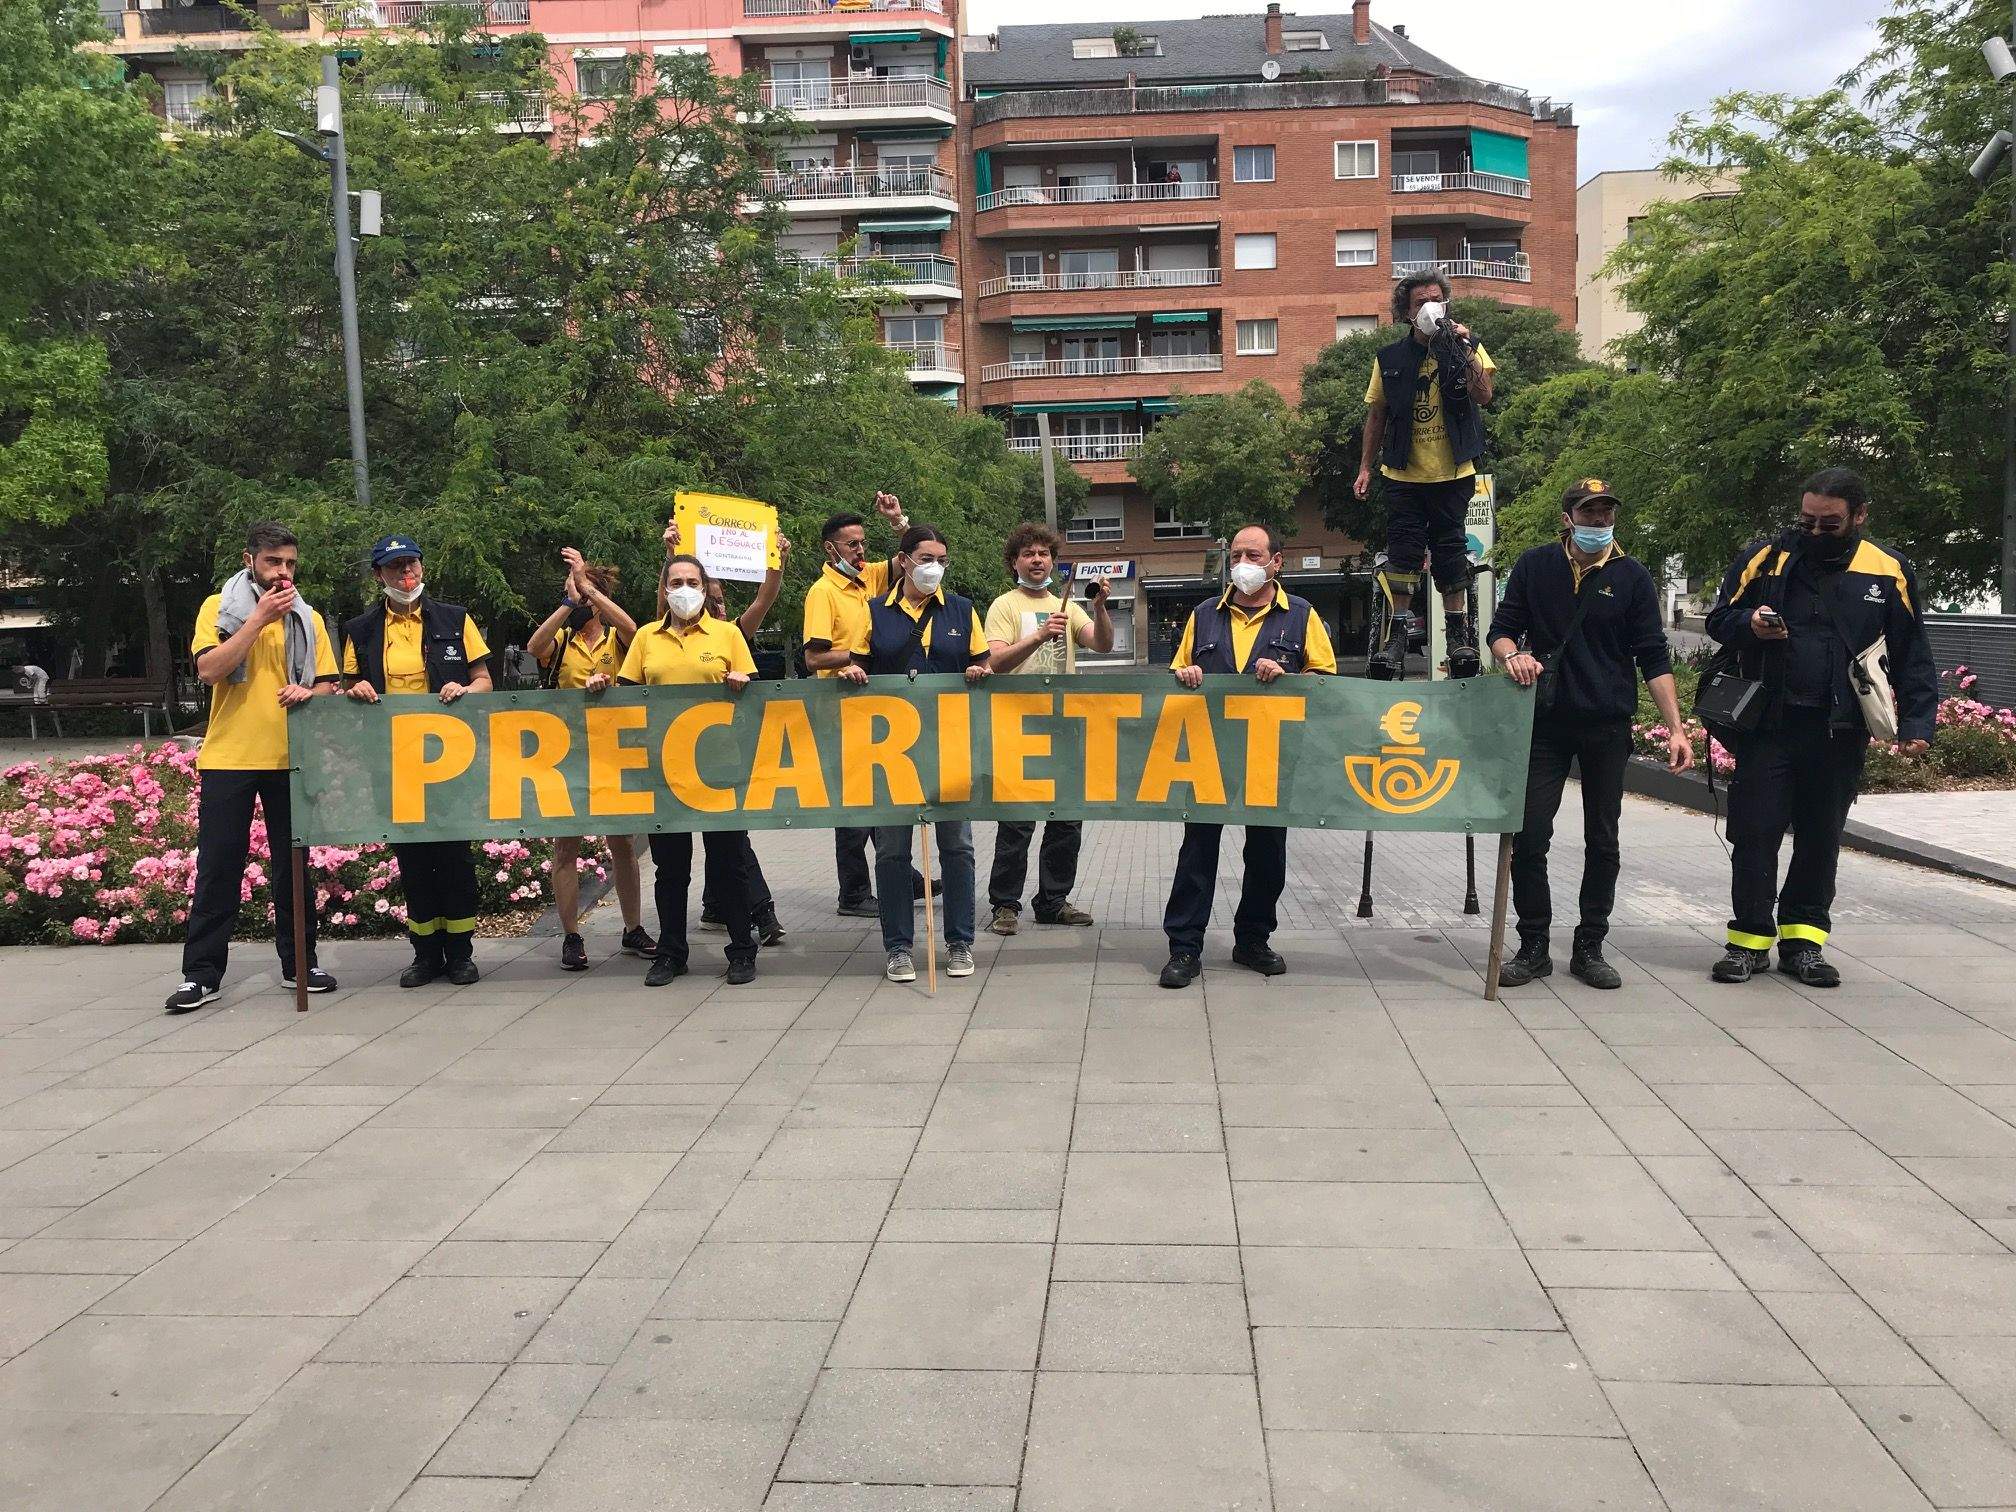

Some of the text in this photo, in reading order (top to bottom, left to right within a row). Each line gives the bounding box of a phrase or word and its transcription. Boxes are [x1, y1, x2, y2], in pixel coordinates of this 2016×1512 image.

[1412, 424, 1445, 436] RREOS
[709, 514, 758, 530] CORREOS
[1466, 517, 1490, 525] UDABLE
[1081, 565, 1112, 575] FIATC
[391, 693, 1306, 823] PRECARIETAT
